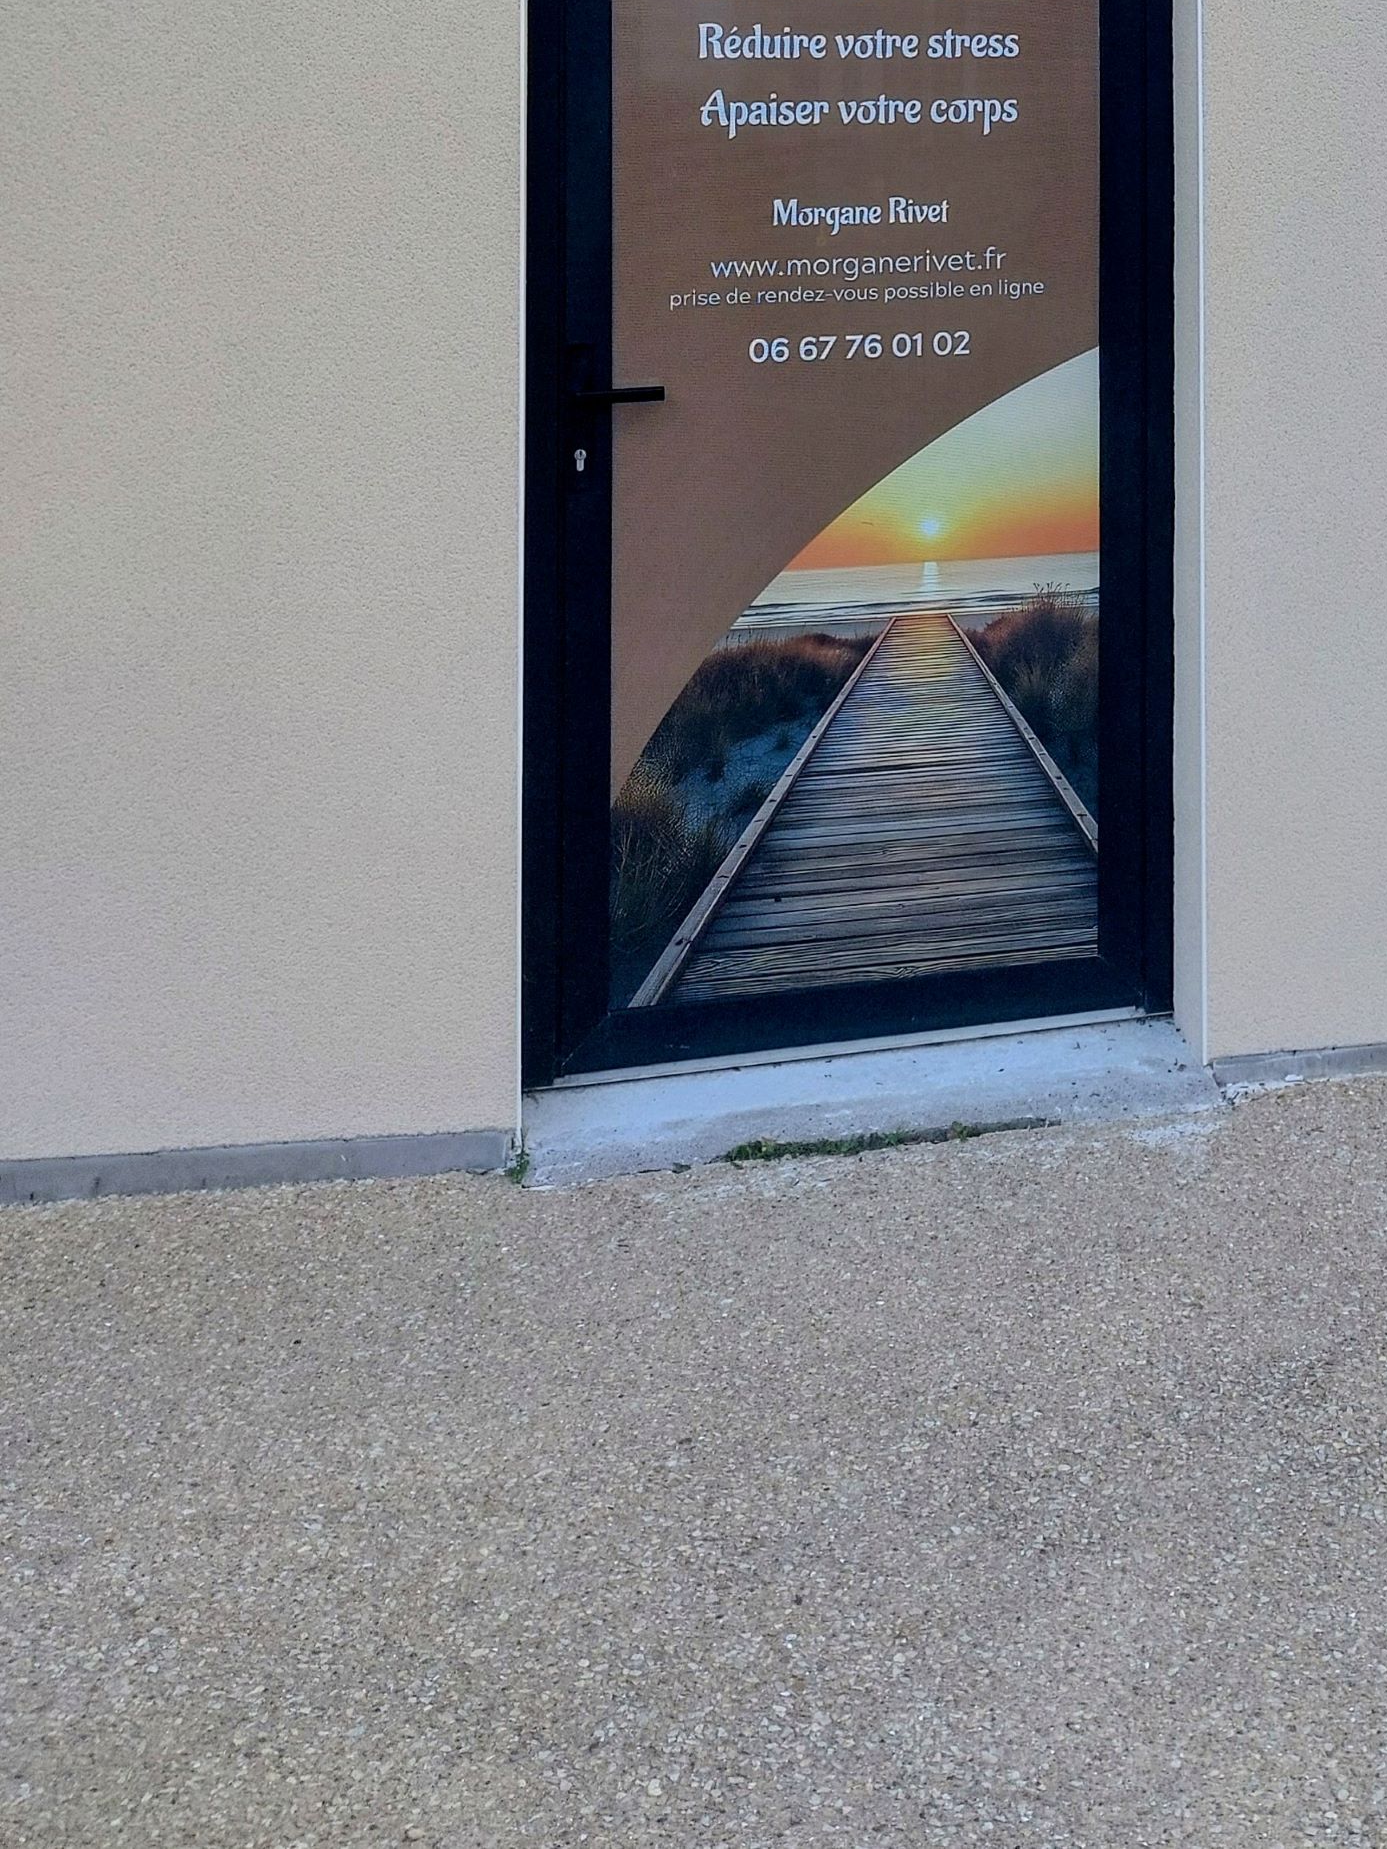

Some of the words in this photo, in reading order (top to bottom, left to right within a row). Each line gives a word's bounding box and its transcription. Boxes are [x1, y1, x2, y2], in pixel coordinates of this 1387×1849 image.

[699, 23, 826, 58] Réduire
[835, 29, 918, 58] votre
[927, 29, 1019, 58] stress
[700, 90, 829, 139] Apaiser
[837, 94, 921, 124] votre
[931, 99, 1017, 135] corps
[773, 199, 881, 235] Morgane
[889, 197, 949, 223] Rivet
[711, 247, 1006, 281] www.morganerivet.fr
[670, 289, 720, 311] prise
[726, 287, 751, 305] de
[758, 285, 879, 304] rendez-vous
[885, 281, 964, 303] possible
[970, 284, 993, 297] en
[999, 279, 1044, 299] ligne
[749, 338, 789, 363] 06
[800, 336, 837, 361] 67
[846, 334, 882, 359] 76
[892, 333, 922, 357] 01
[933, 331, 970, 356] 02
